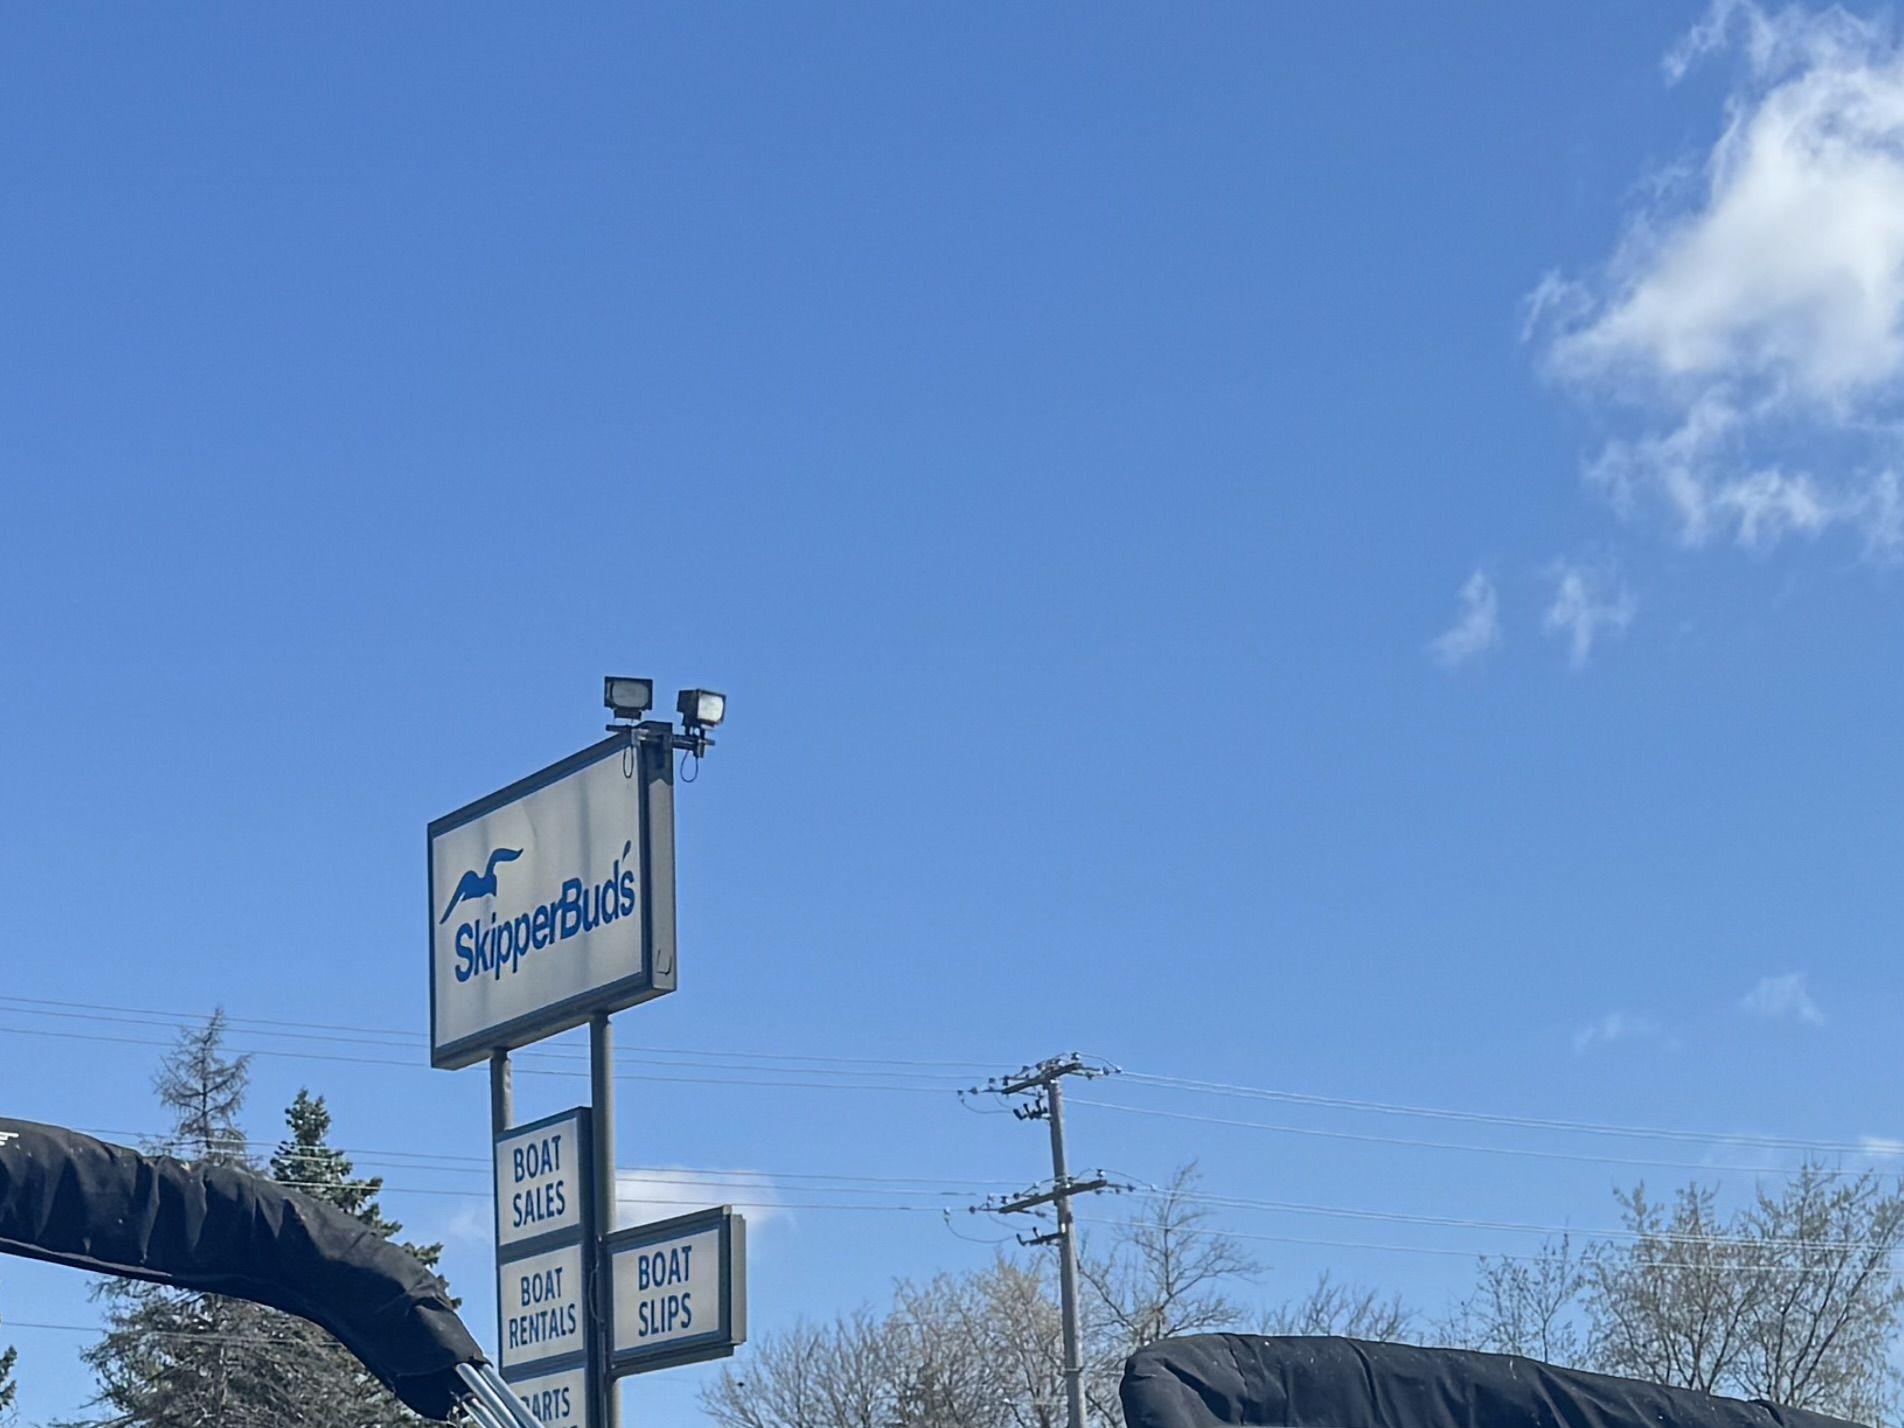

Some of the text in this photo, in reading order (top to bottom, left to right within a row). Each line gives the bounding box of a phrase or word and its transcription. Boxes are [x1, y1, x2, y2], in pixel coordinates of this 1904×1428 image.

[512, 1134, 562, 1183] BOAT
[512, 1179, 566, 1228] SALES
[520, 1266, 564, 1307] BOAT
[637, 1244, 693, 1291] BOAT
[508, 1303, 577, 1349] RENTALS
[637, 1292, 693, 1338] SLIPS
